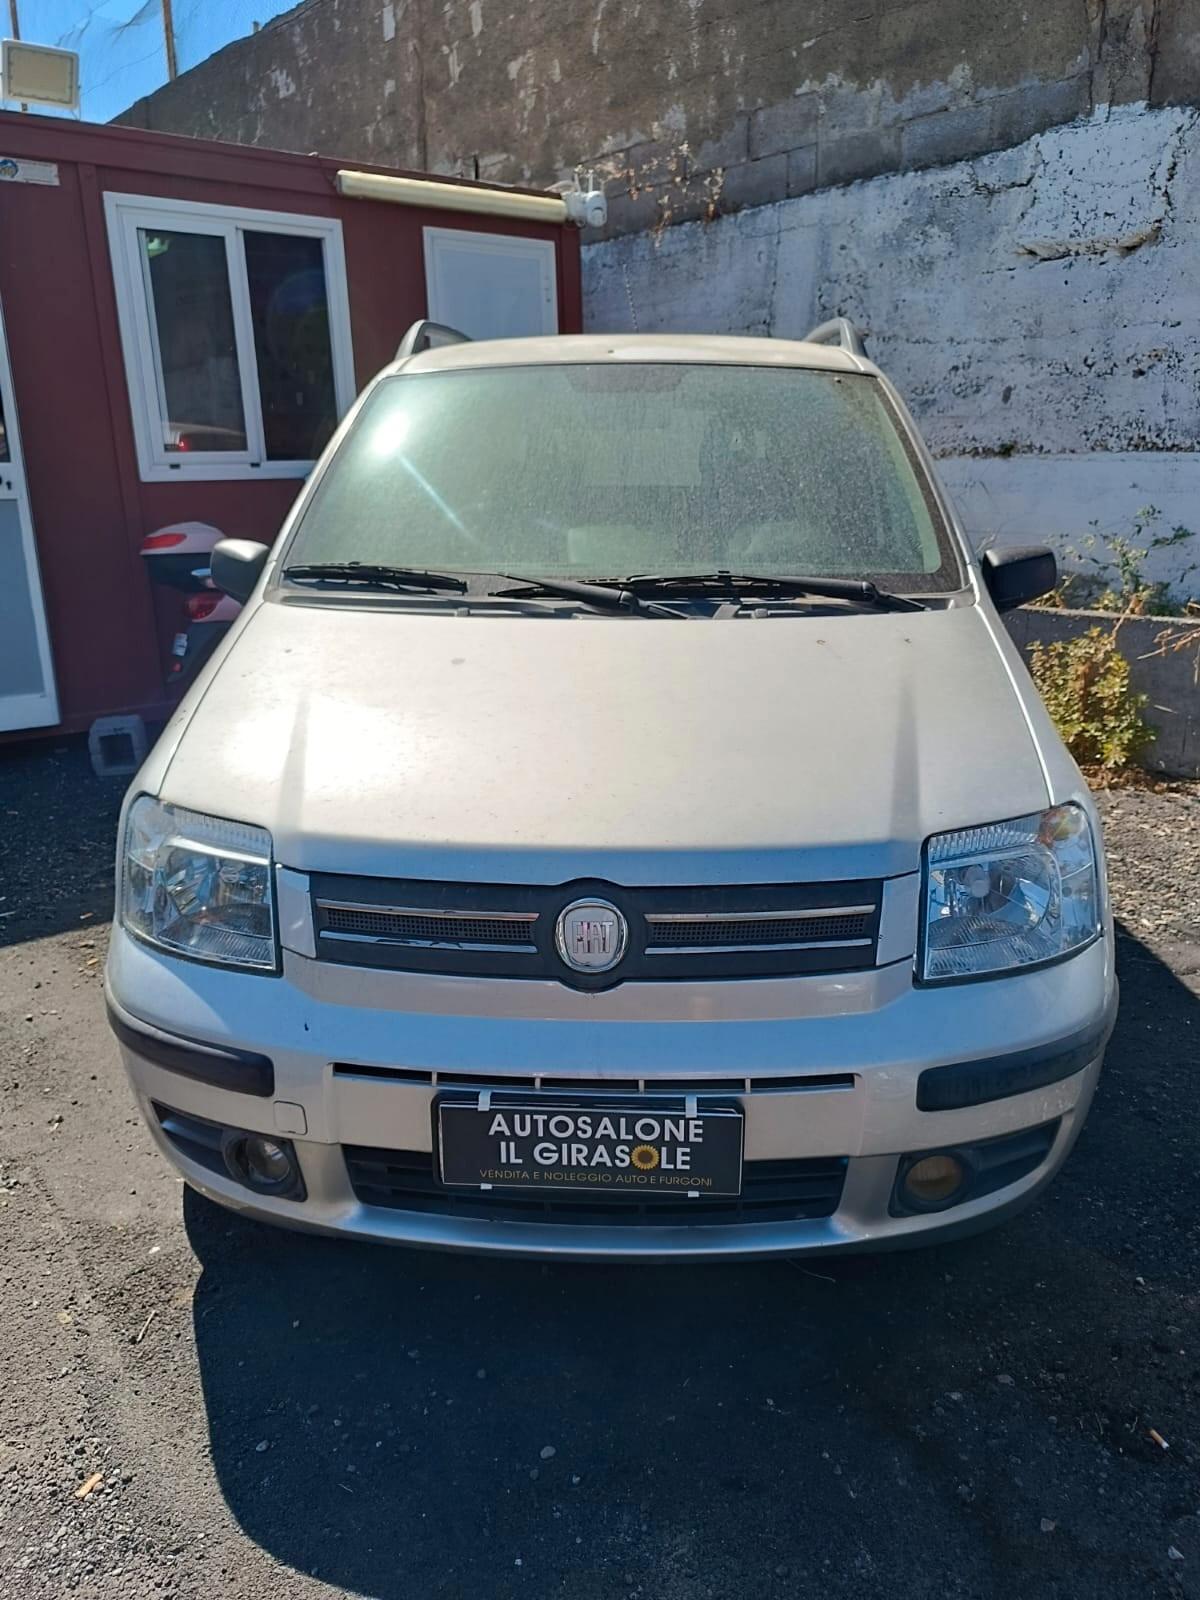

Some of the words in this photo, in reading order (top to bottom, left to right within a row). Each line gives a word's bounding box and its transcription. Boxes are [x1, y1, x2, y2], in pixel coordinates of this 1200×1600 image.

[572, 920, 613, 953] FIAT
[488, 1113, 704, 1143] AUTOSALONE
[500, 1141, 523, 1164] IL
[533, 1142, 691, 1170] GIRASOLE
[479, 1169, 530, 1179] VENDITA
[533, 1171, 540, 1179] E
[544, 1171, 612, 1183] NOLEGGIO
[616, 1174, 648, 1184] AUTO
[650, 1175, 657, 1184] E
[660, 1175, 712, 1187] FURGONI
